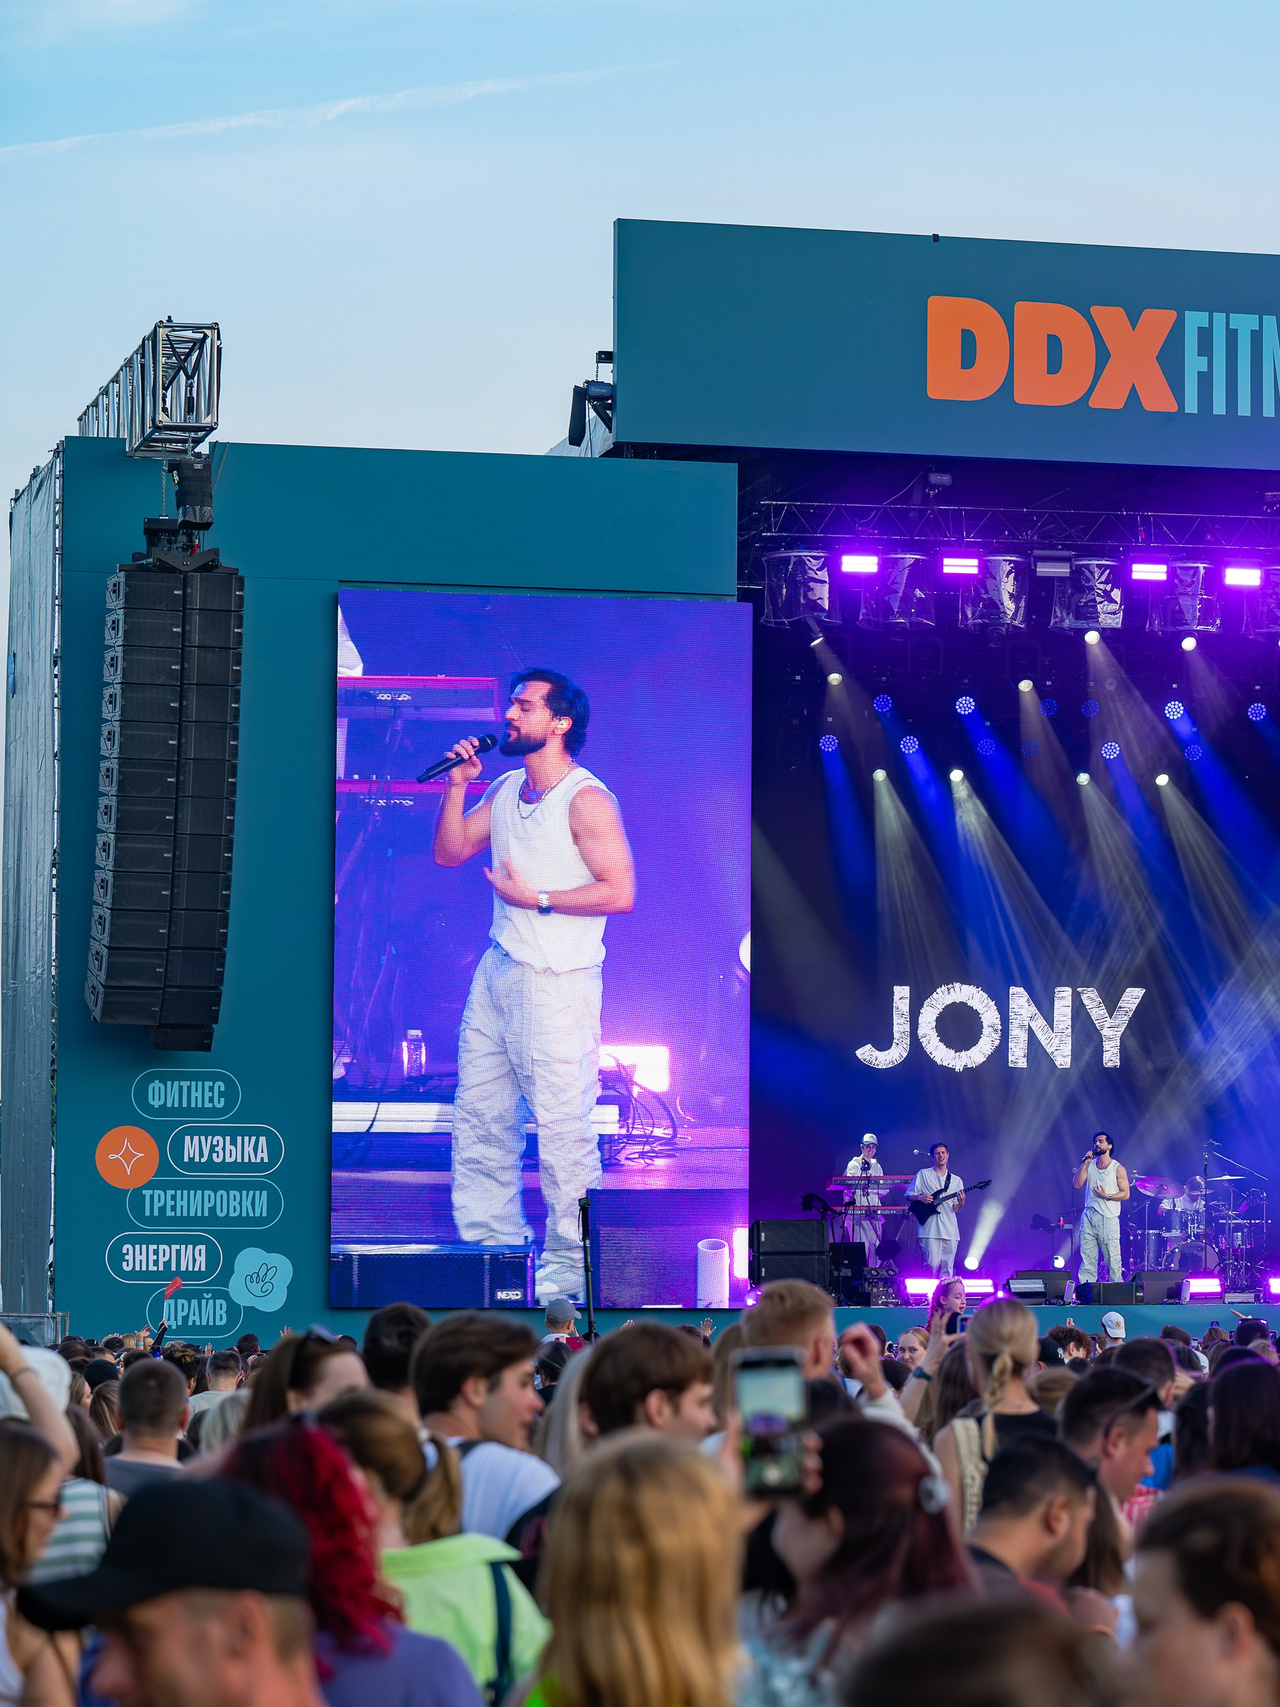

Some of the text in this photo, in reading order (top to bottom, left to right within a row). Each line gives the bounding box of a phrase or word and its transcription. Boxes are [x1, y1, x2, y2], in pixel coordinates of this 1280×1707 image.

[926, 295, 1178, 413] DDX
[855, 981, 1146, 1072] JONY
[148, 1079, 225, 1109] ФИТНЕС
[183, 1135, 269, 1163] МУЗЫКА
[142, 1189, 268, 1218] ТРЕНИРОВКИ
[122, 1243, 206, 1272] ЭНЕРГИЯ
[164, 1293, 227, 1329] ДРАЙВ
